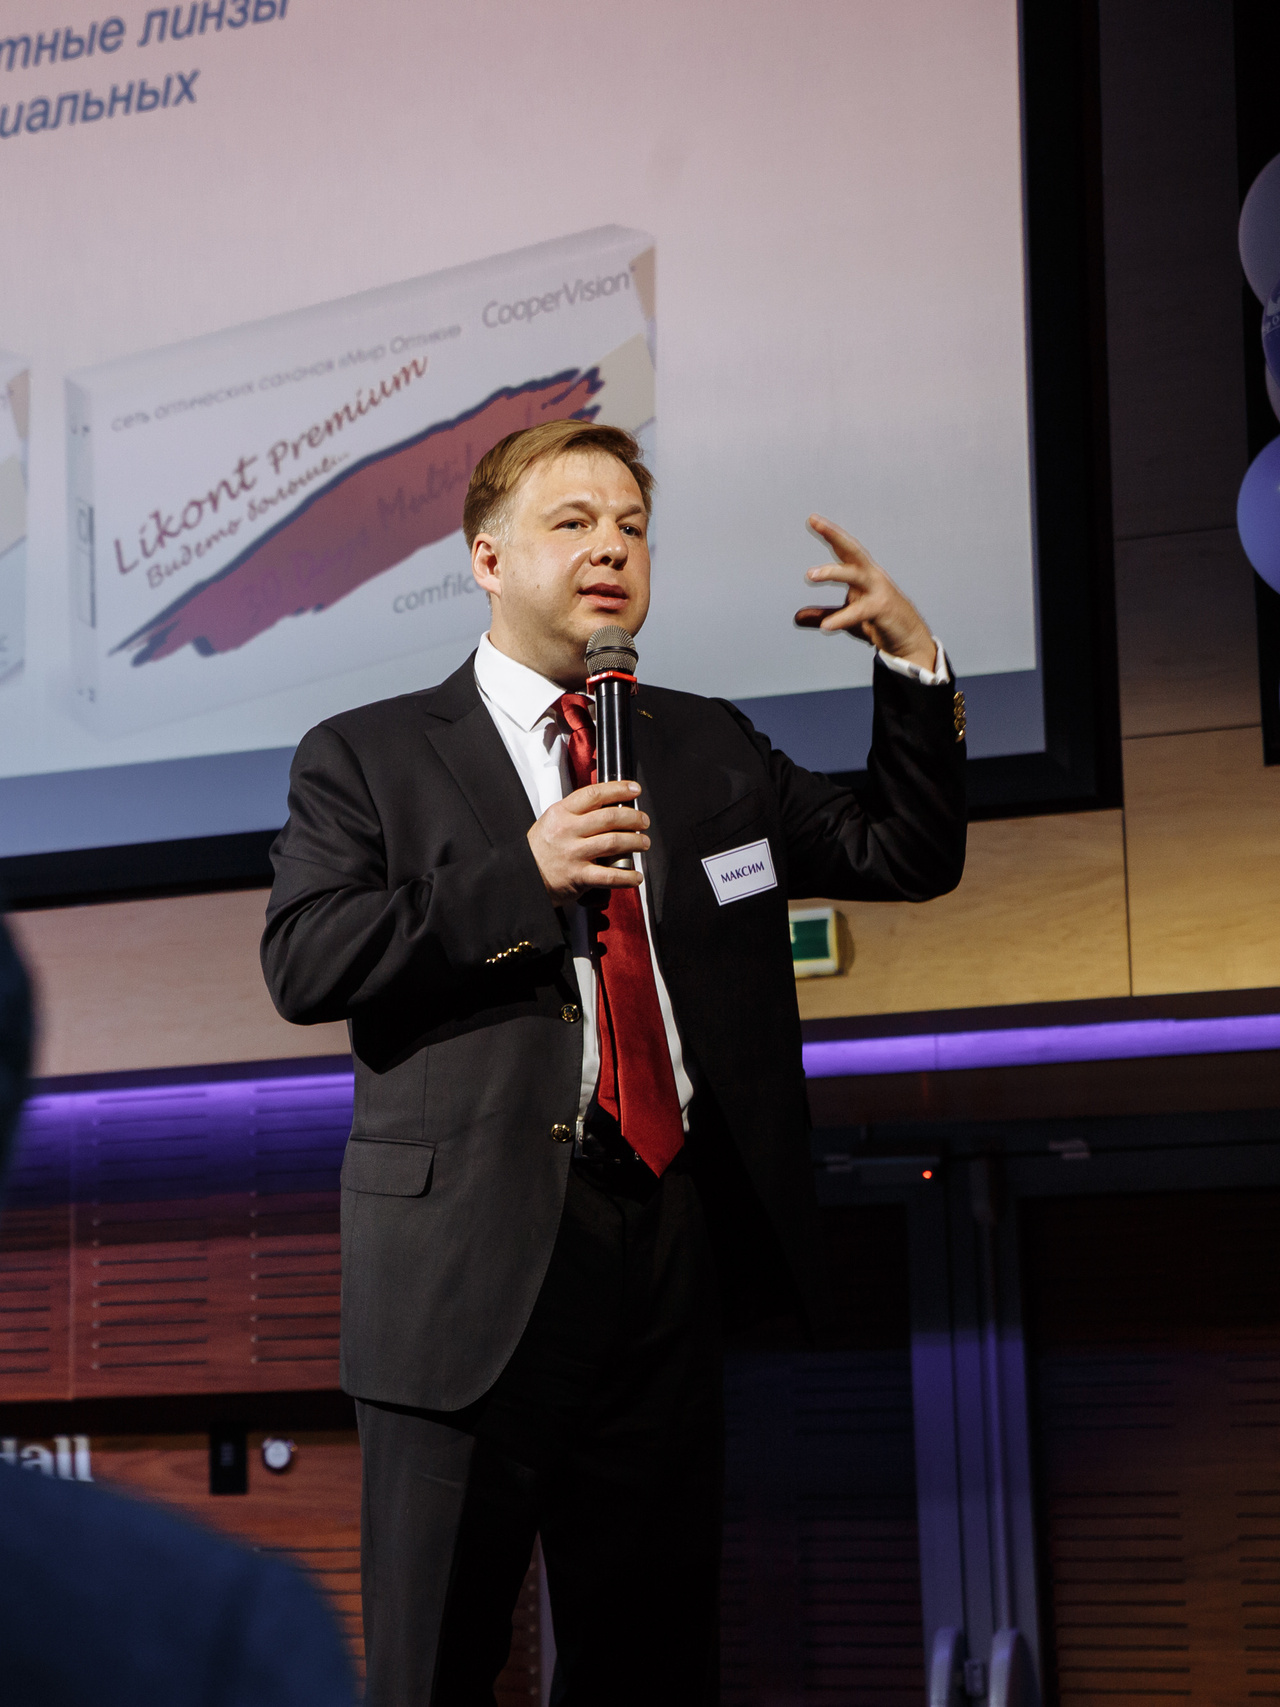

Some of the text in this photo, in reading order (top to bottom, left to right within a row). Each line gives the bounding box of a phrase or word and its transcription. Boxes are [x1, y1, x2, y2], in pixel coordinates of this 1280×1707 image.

[137, 0, 289, 47] линзы
[482, 271, 630, 330] CooperVision
[113, 354, 429, 575] Likont Premium
[720, 860, 765, 884] МАКСИМ
